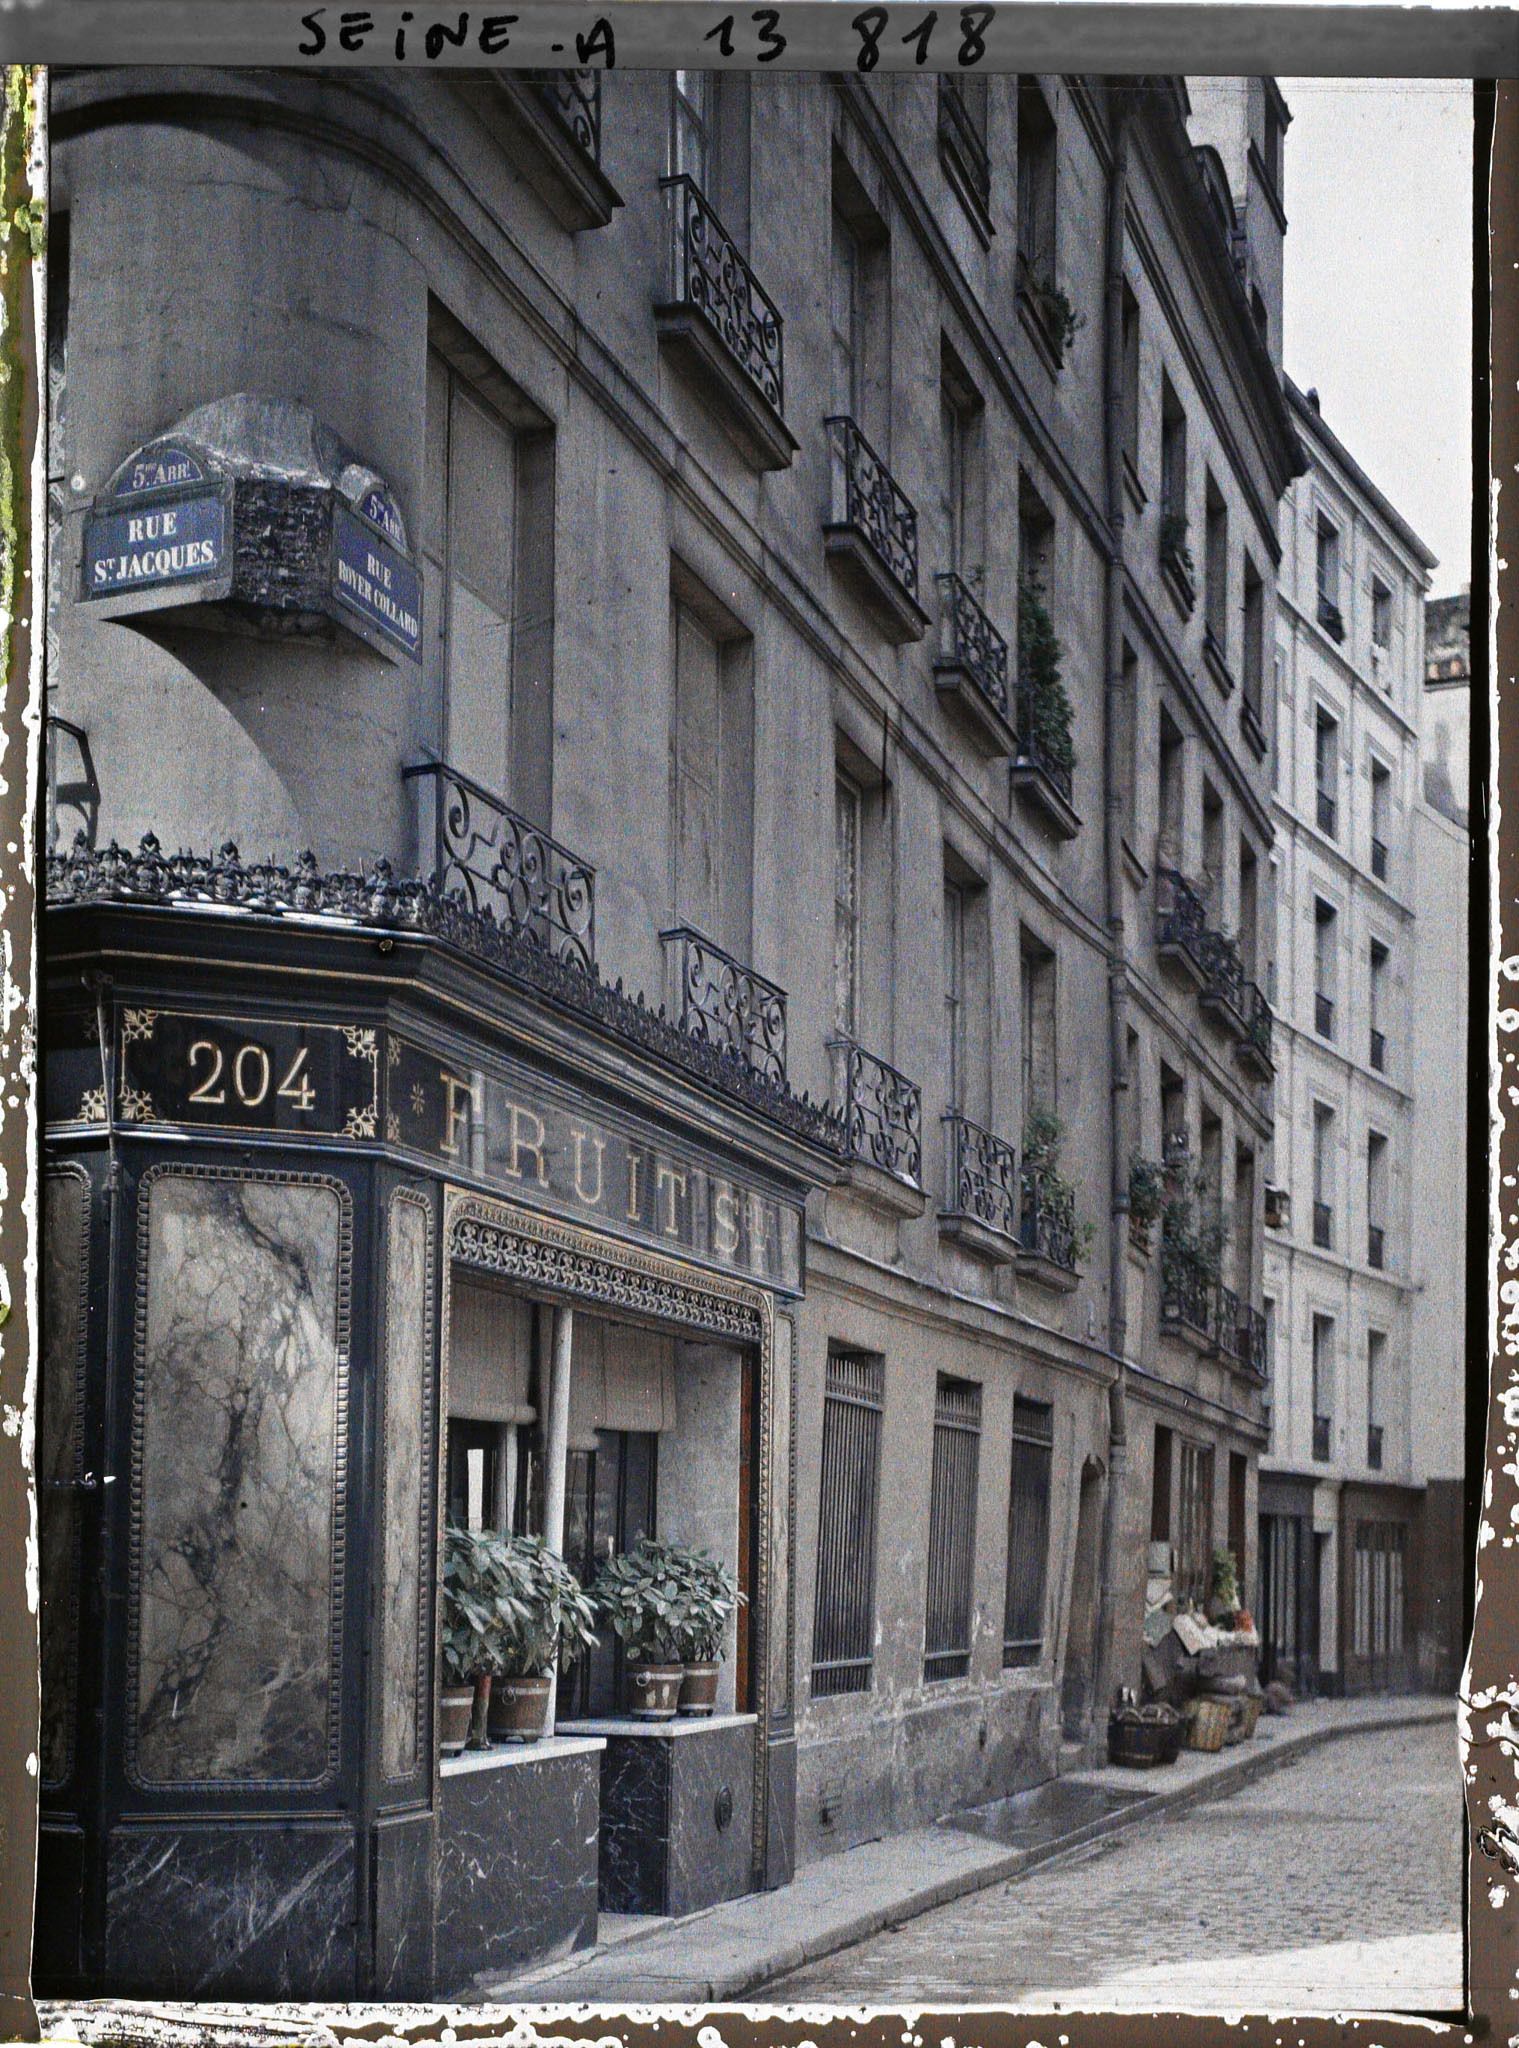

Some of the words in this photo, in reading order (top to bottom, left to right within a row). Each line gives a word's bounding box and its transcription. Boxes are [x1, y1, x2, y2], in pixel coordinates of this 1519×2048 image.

[703, 9, 787, 62] 13
[851, 4, 997, 72] 818
[116, 540, 214, 579] JACQUES
[128, 511, 177, 543] RUE
[338, 558, 372, 602] ROYER
[373, 588, 418, 639] COLLARD
[367, 552, 392, 590] RUE
[187, 1040, 316, 1112] 204
[438, 1071, 740, 1252] FRUITS
